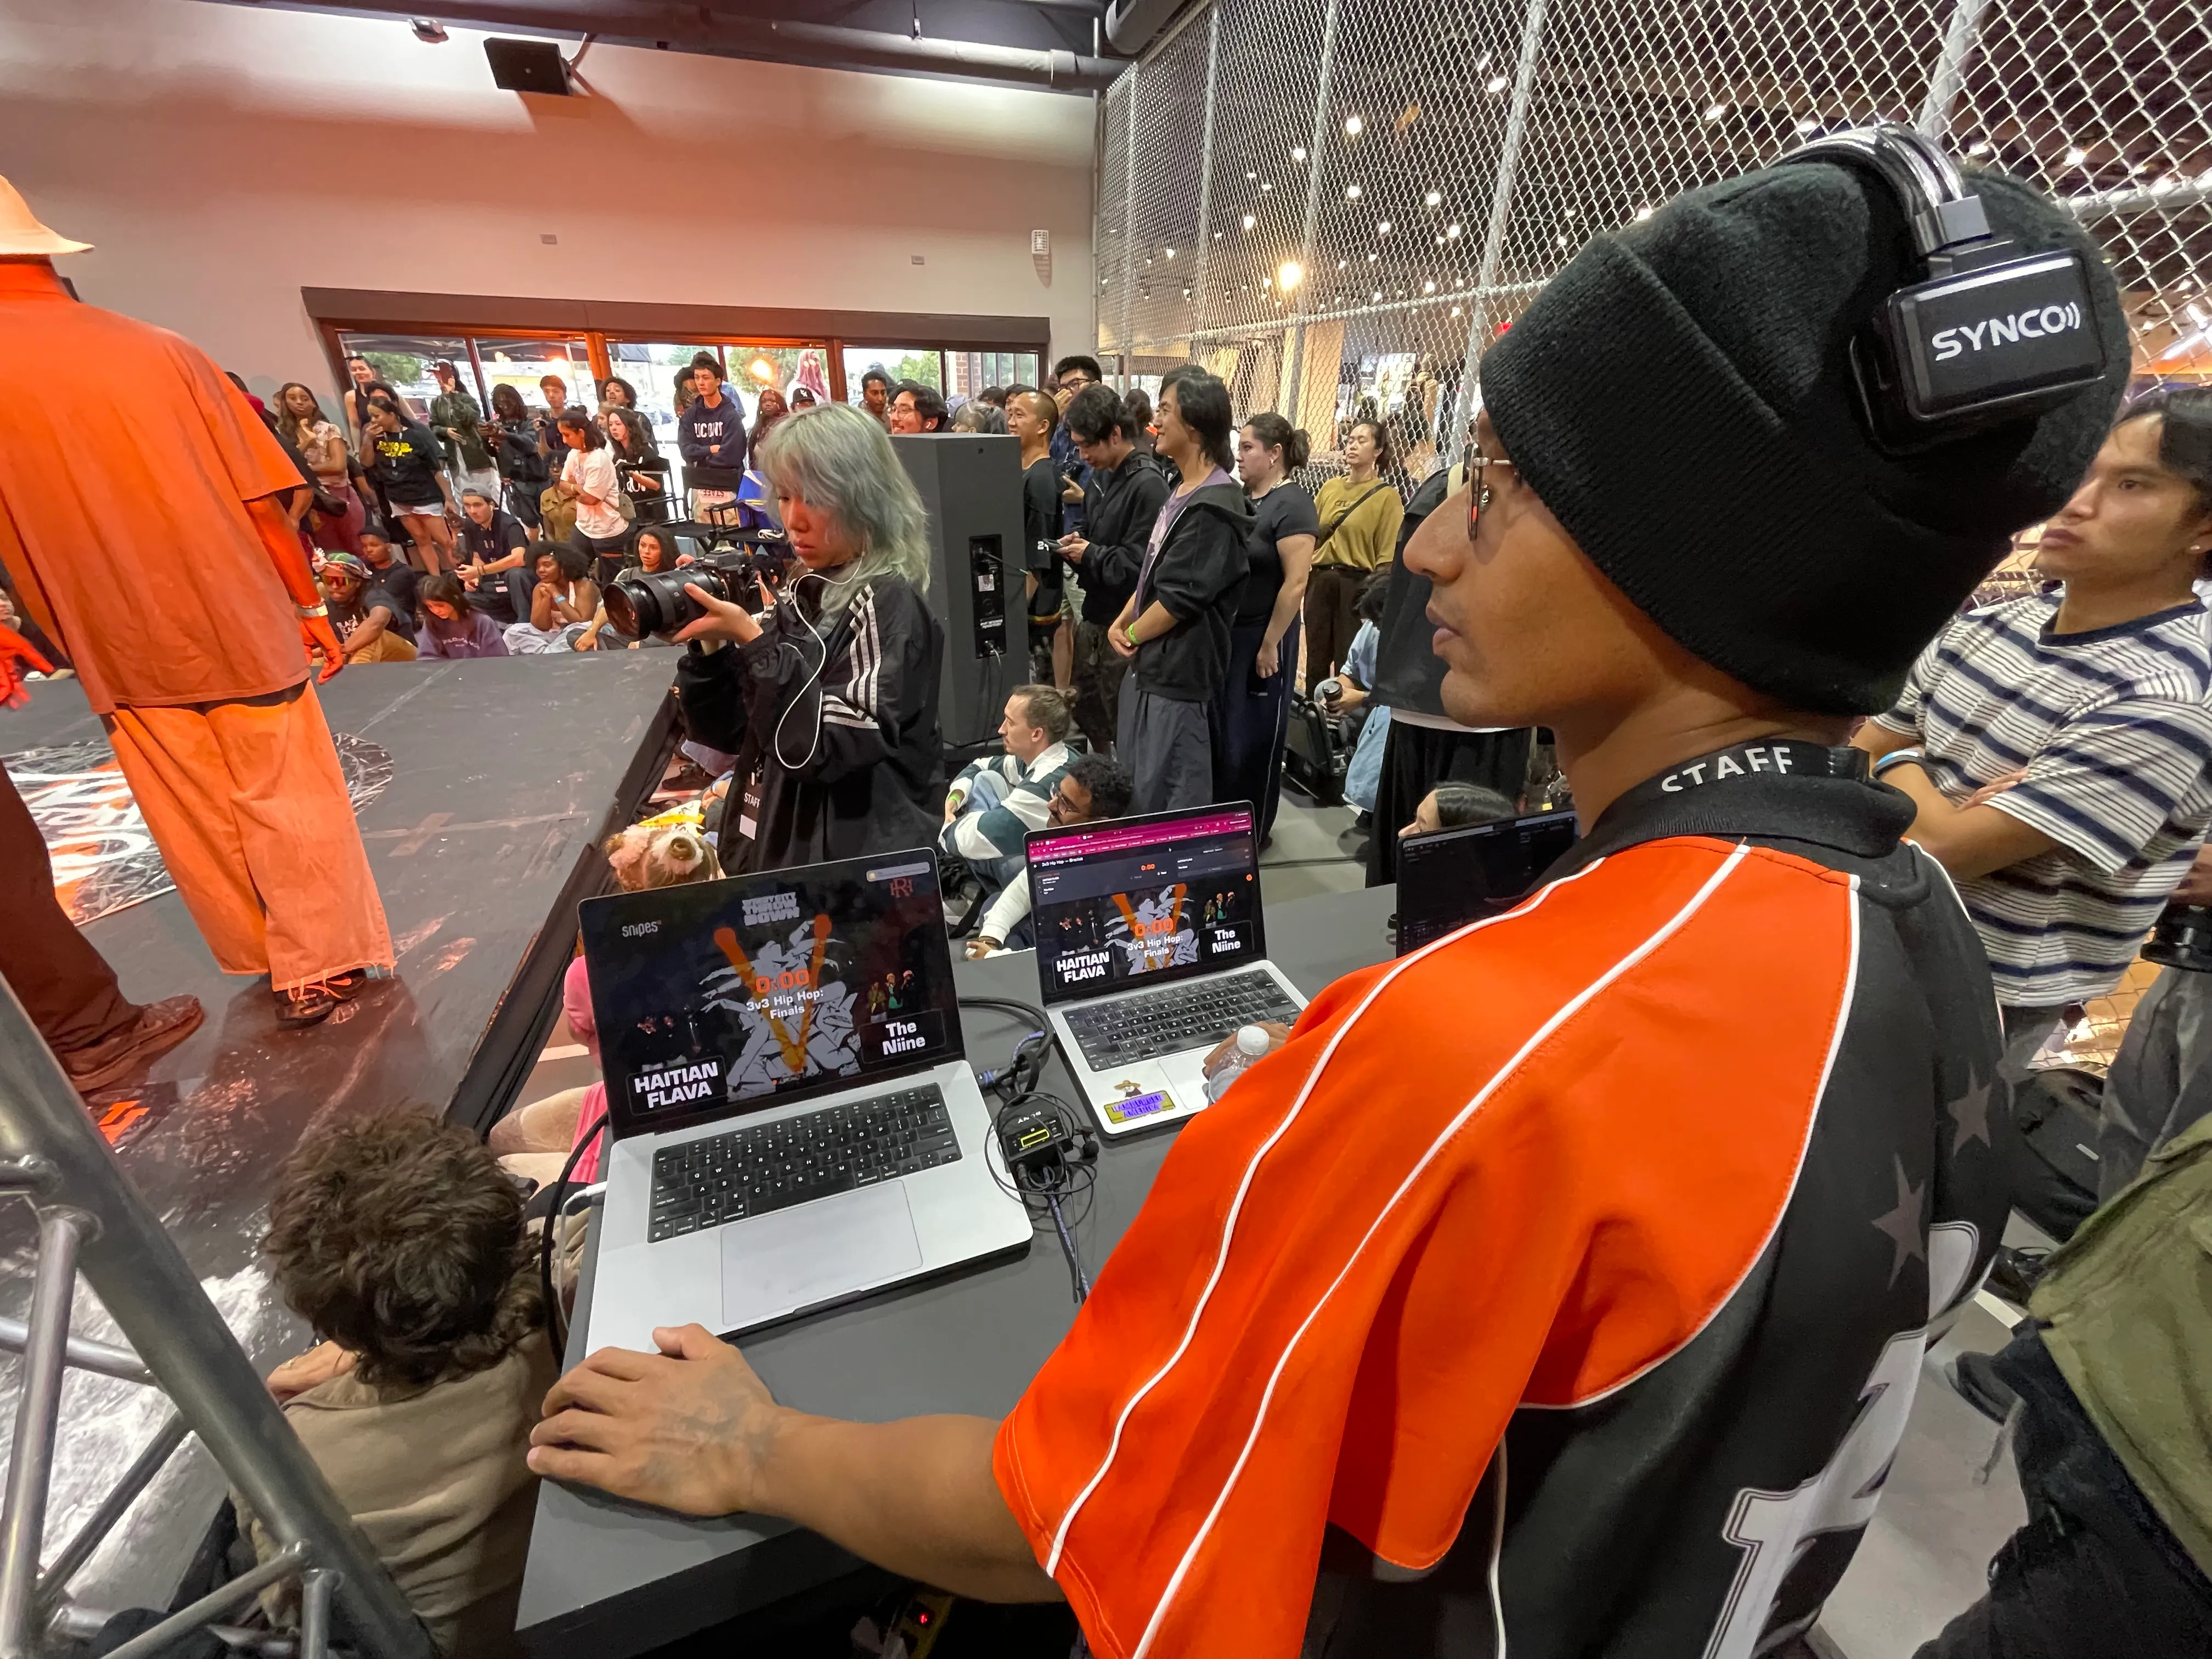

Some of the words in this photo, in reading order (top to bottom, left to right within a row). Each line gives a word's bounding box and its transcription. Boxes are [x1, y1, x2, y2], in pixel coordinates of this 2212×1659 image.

[1932, 305, 2067, 361] SYNCO
[1661, 746, 1793, 792] STAFF
[622, 921, 658, 938] snipes
[1135, 917, 1174, 937] 0:00
[1214, 929, 1235, 940] The
[1127, 941, 1144, 951] 3v3
[1147, 938, 1161, 949] Hip
[1164, 934, 1183, 946] Hop:
[1144, 947, 1170, 958] Finals
[1212, 940, 1241, 953] Niine
[1056, 951, 1110, 972] HAITIAN
[755, 969, 810, 994] 0:00
[1063, 965, 1106, 983] FLAVA
[746, 998, 770, 1011] 3v3
[774, 995, 793, 1006] Hip
[797, 989, 824, 1001] Hop:
[770, 1005, 805, 1019] Finals
[885, 1022, 917, 1037] The
[882, 1036, 926, 1056] Niine
[634, 1061, 719, 1093] HAITIAN
[646, 1081, 713, 1109] FLAVA
